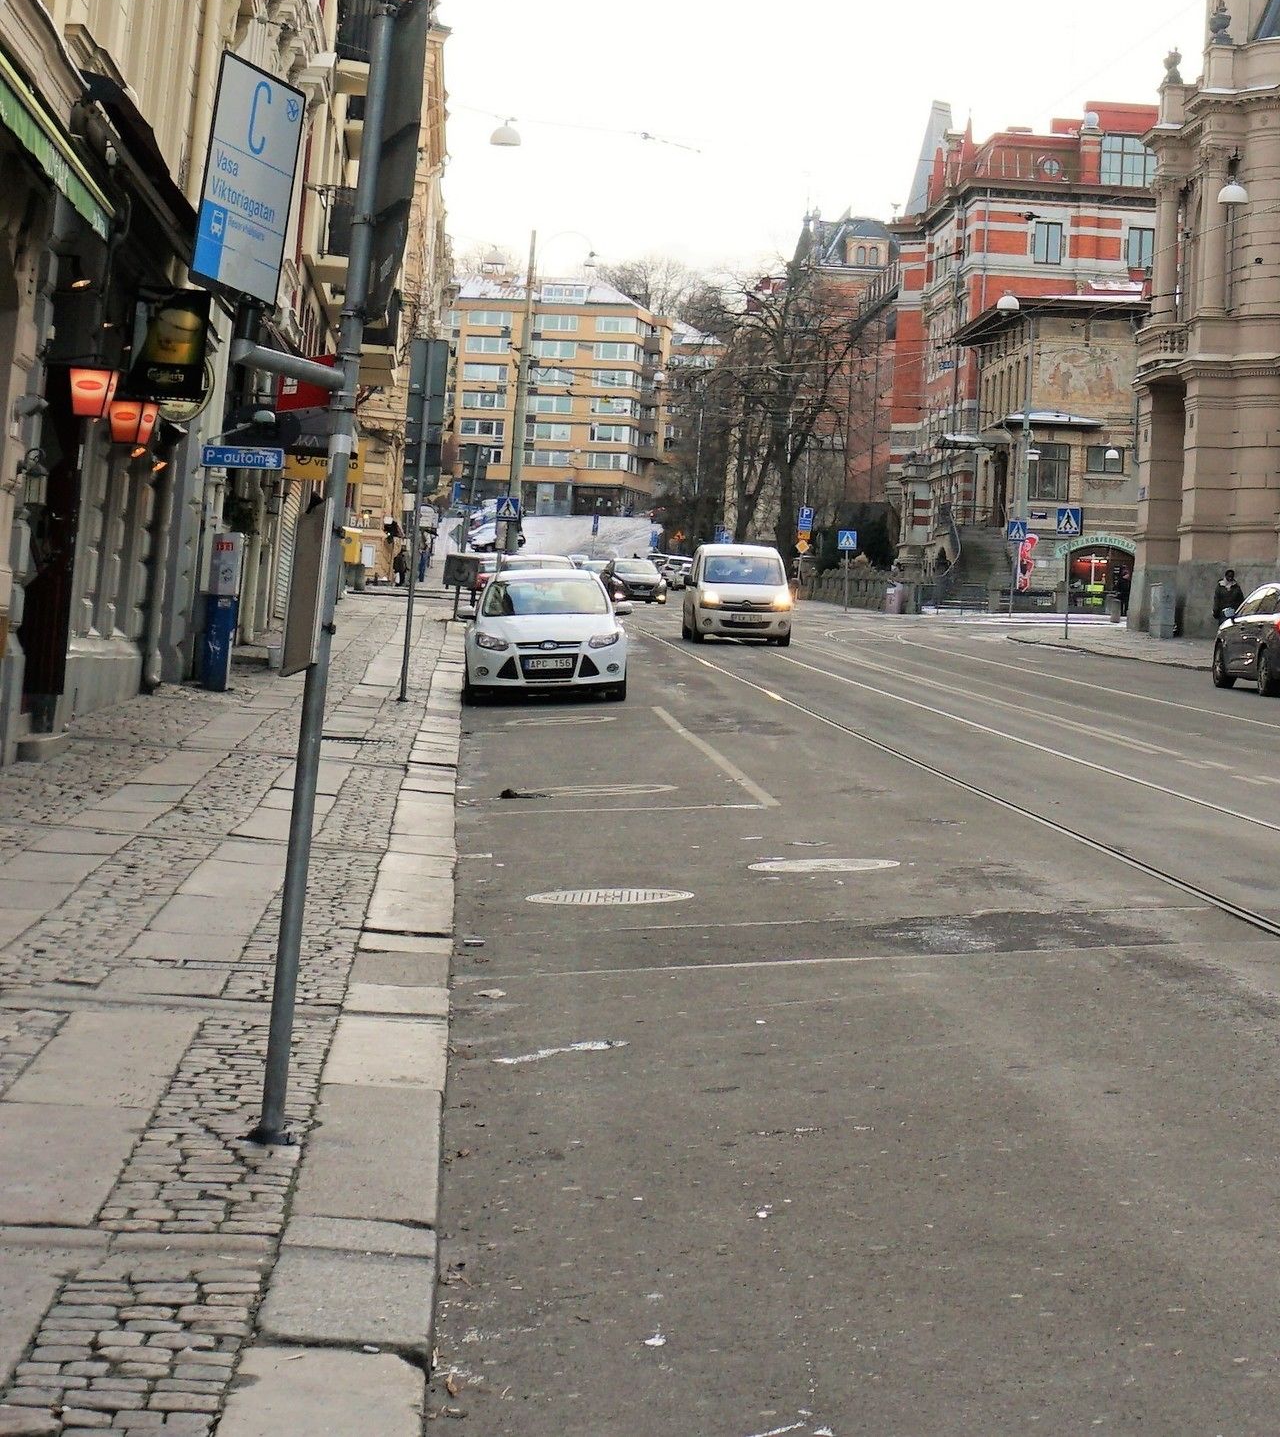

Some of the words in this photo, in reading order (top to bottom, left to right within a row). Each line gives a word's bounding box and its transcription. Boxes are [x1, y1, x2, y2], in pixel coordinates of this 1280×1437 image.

[248, 80, 272, 156] C
[216, 149, 239, 177] Vasa
[212, 175, 275, 222] Viktoriagatan
[554, 658, 571, 668] 156
